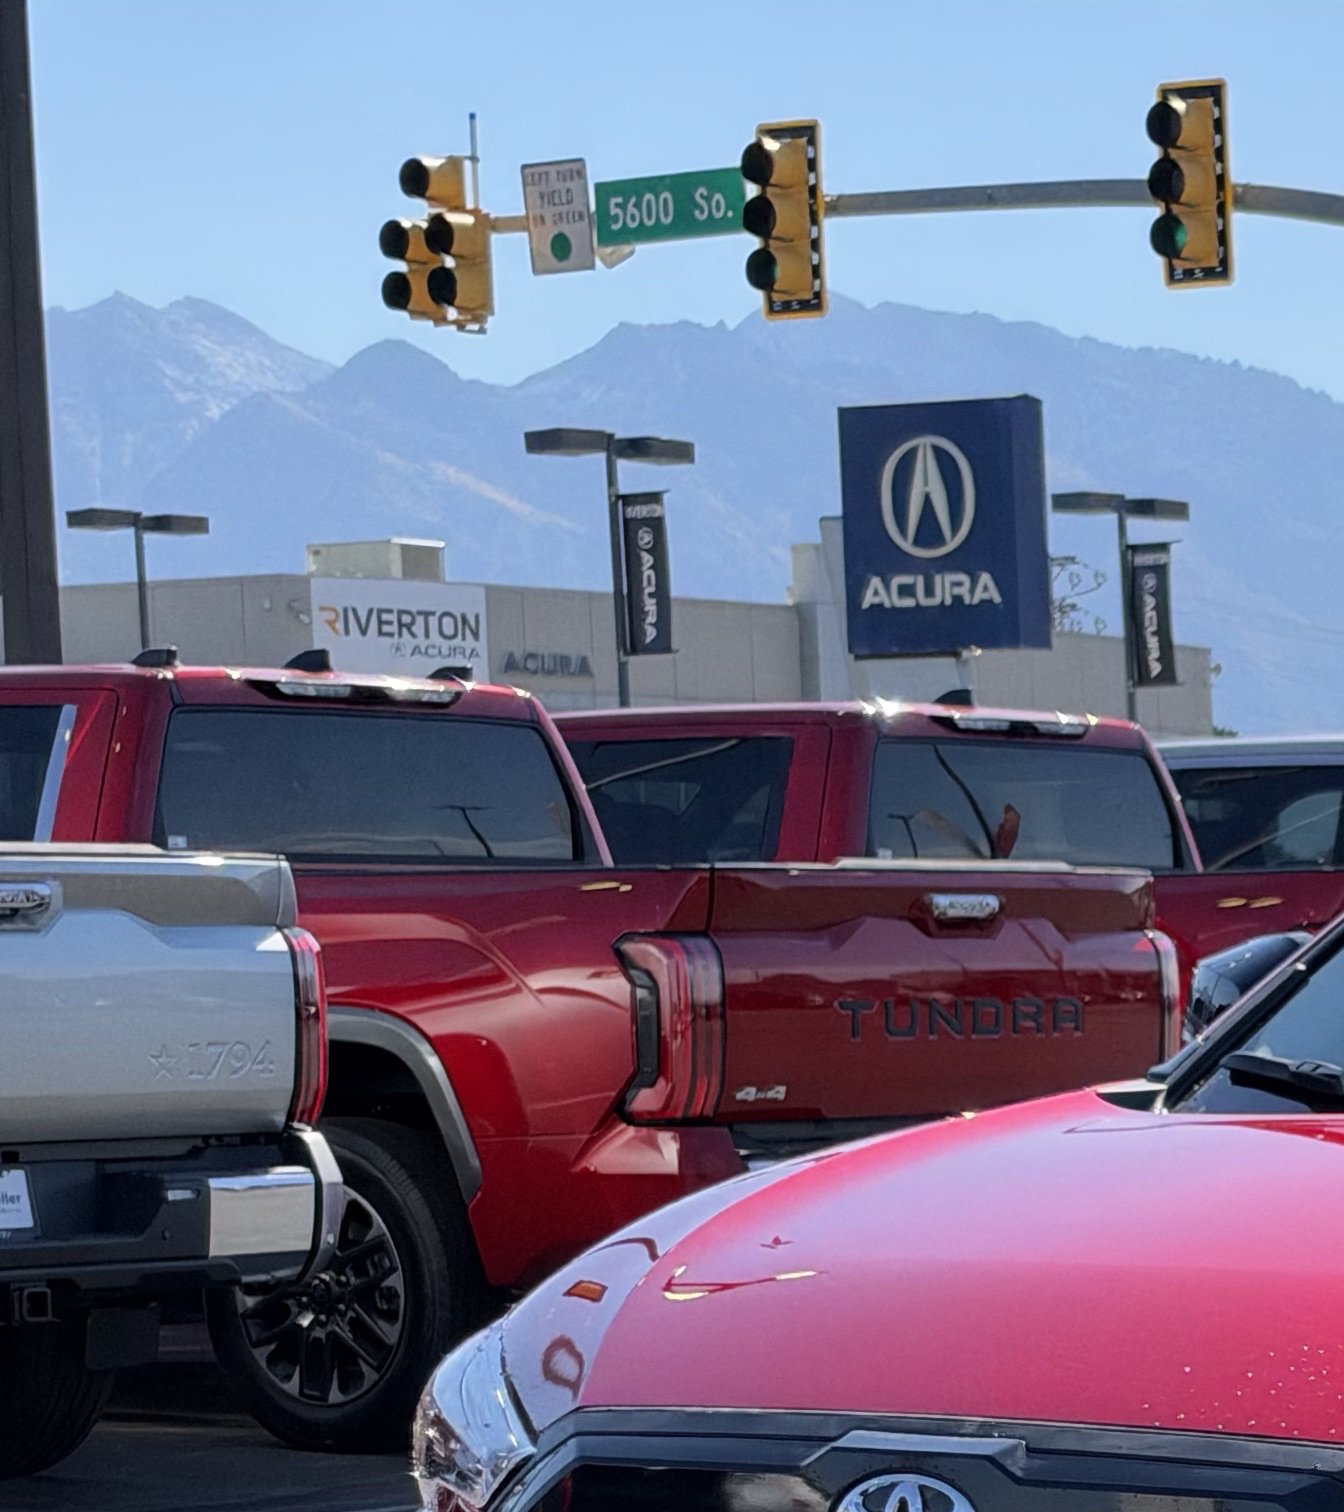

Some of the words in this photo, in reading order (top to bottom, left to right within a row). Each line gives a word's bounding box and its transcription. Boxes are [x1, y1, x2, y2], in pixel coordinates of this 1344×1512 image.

[539, 187, 574, 209] YIELD
[608, 191, 675, 231] 5600
[693, 186, 734, 221] So.
[639, 550, 659, 645] ACURA
[861, 570, 1003, 611] ACURA
[317, 605, 481, 643] RIVERTON
[410, 643, 482, 661] ACURA
[503, 652, 595, 678] ACURA
[834, 997, 1084, 1040] TUNDRA
[187, 1039, 275, 1080] 1794
